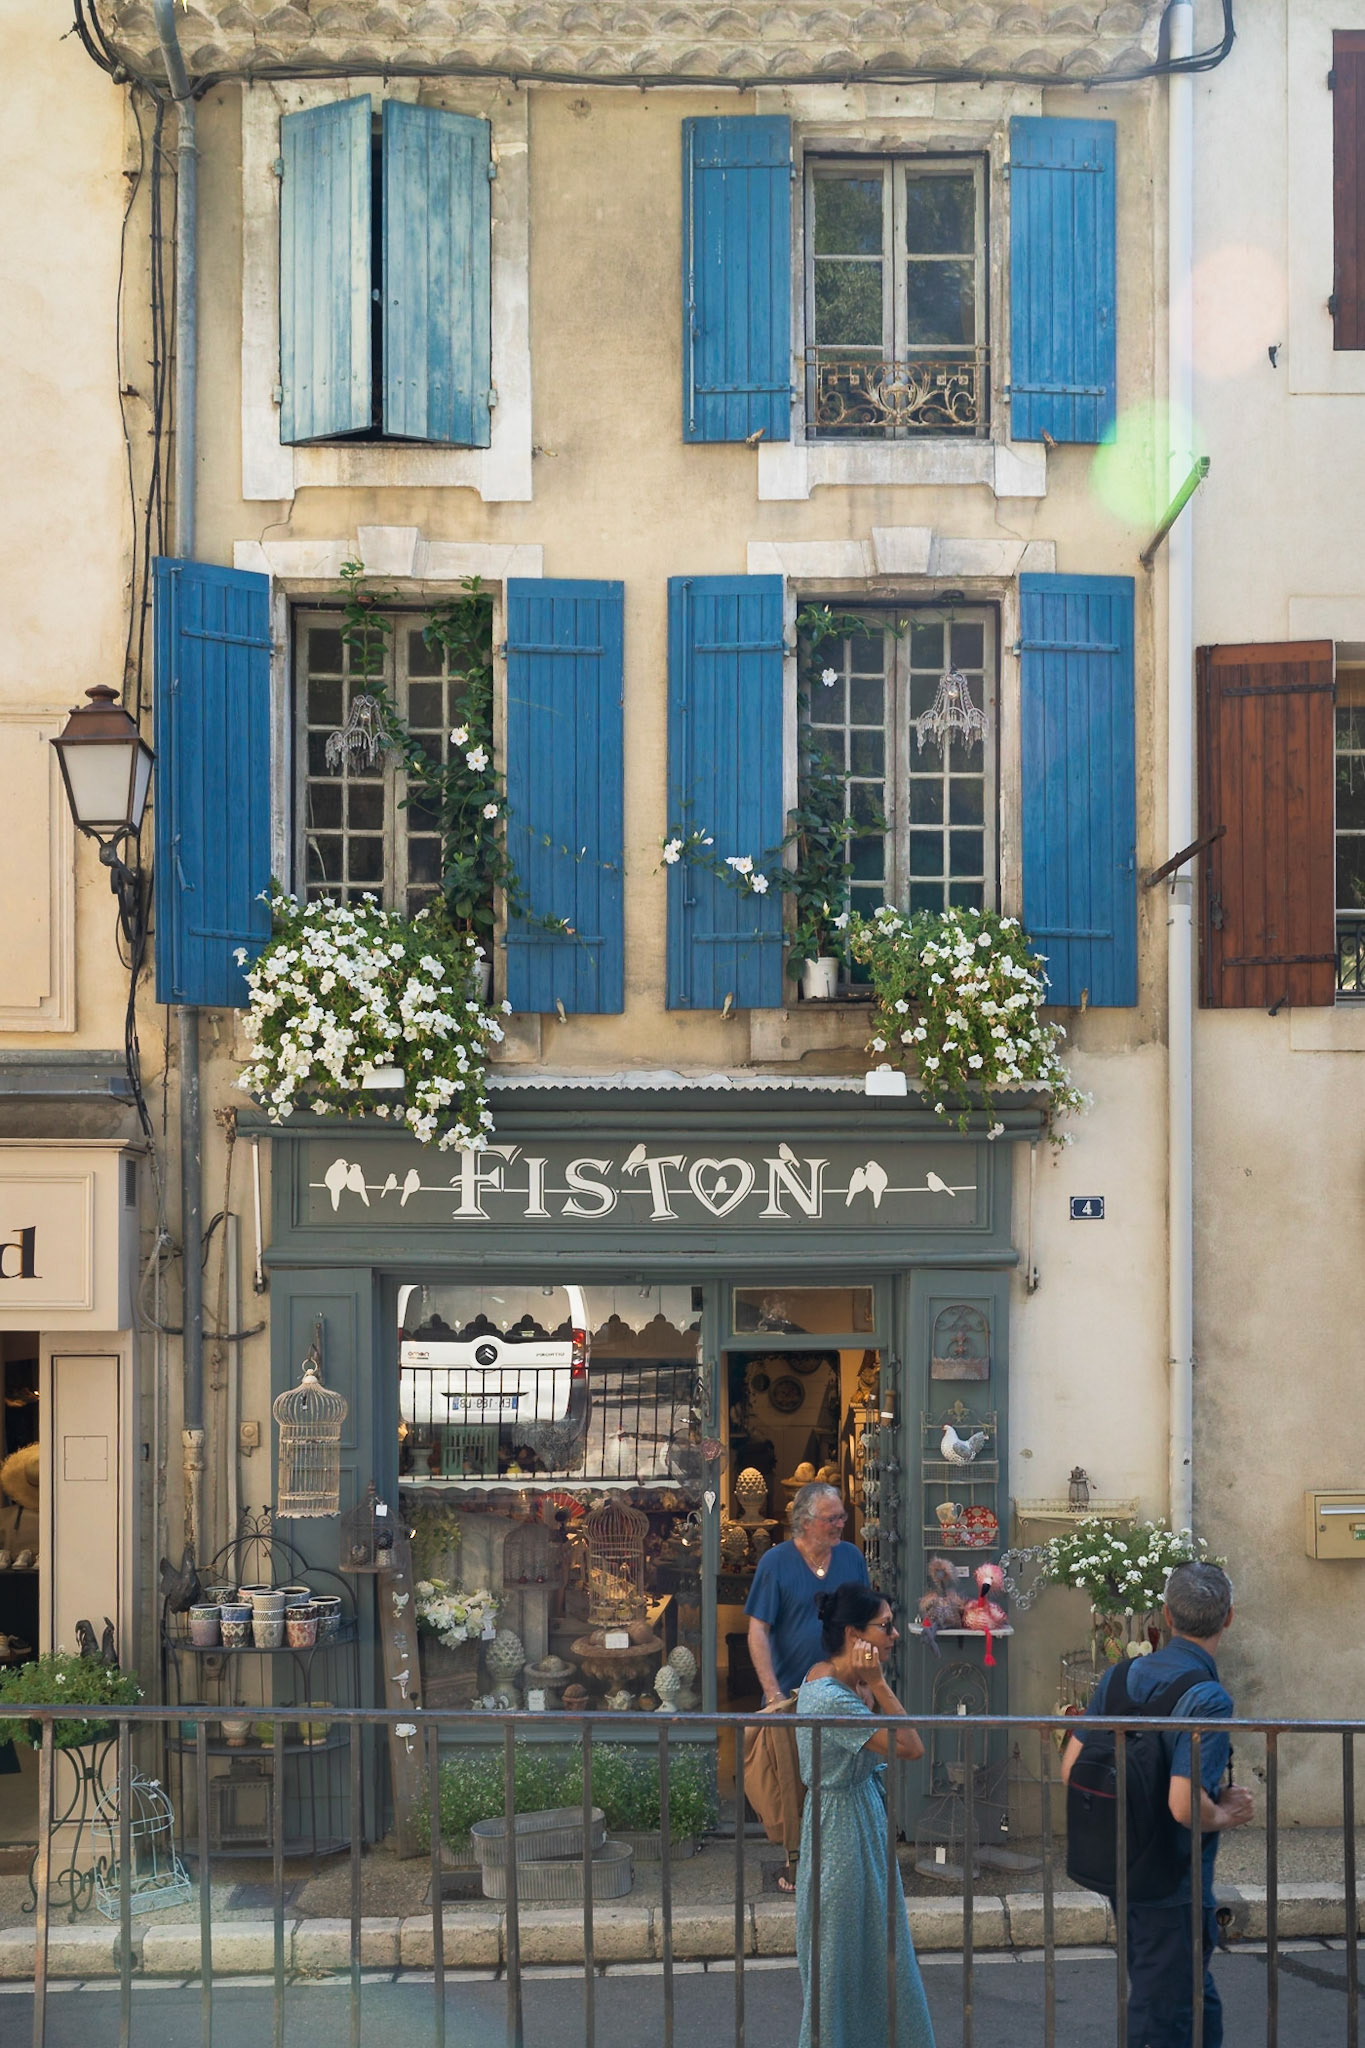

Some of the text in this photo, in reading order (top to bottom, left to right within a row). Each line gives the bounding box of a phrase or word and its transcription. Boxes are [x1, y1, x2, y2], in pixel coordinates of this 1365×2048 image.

[450, 1144, 830, 1221] FISTON
[1081, 1200, 1093, 1215] 4
[0, 1225, 43, 1279] d
